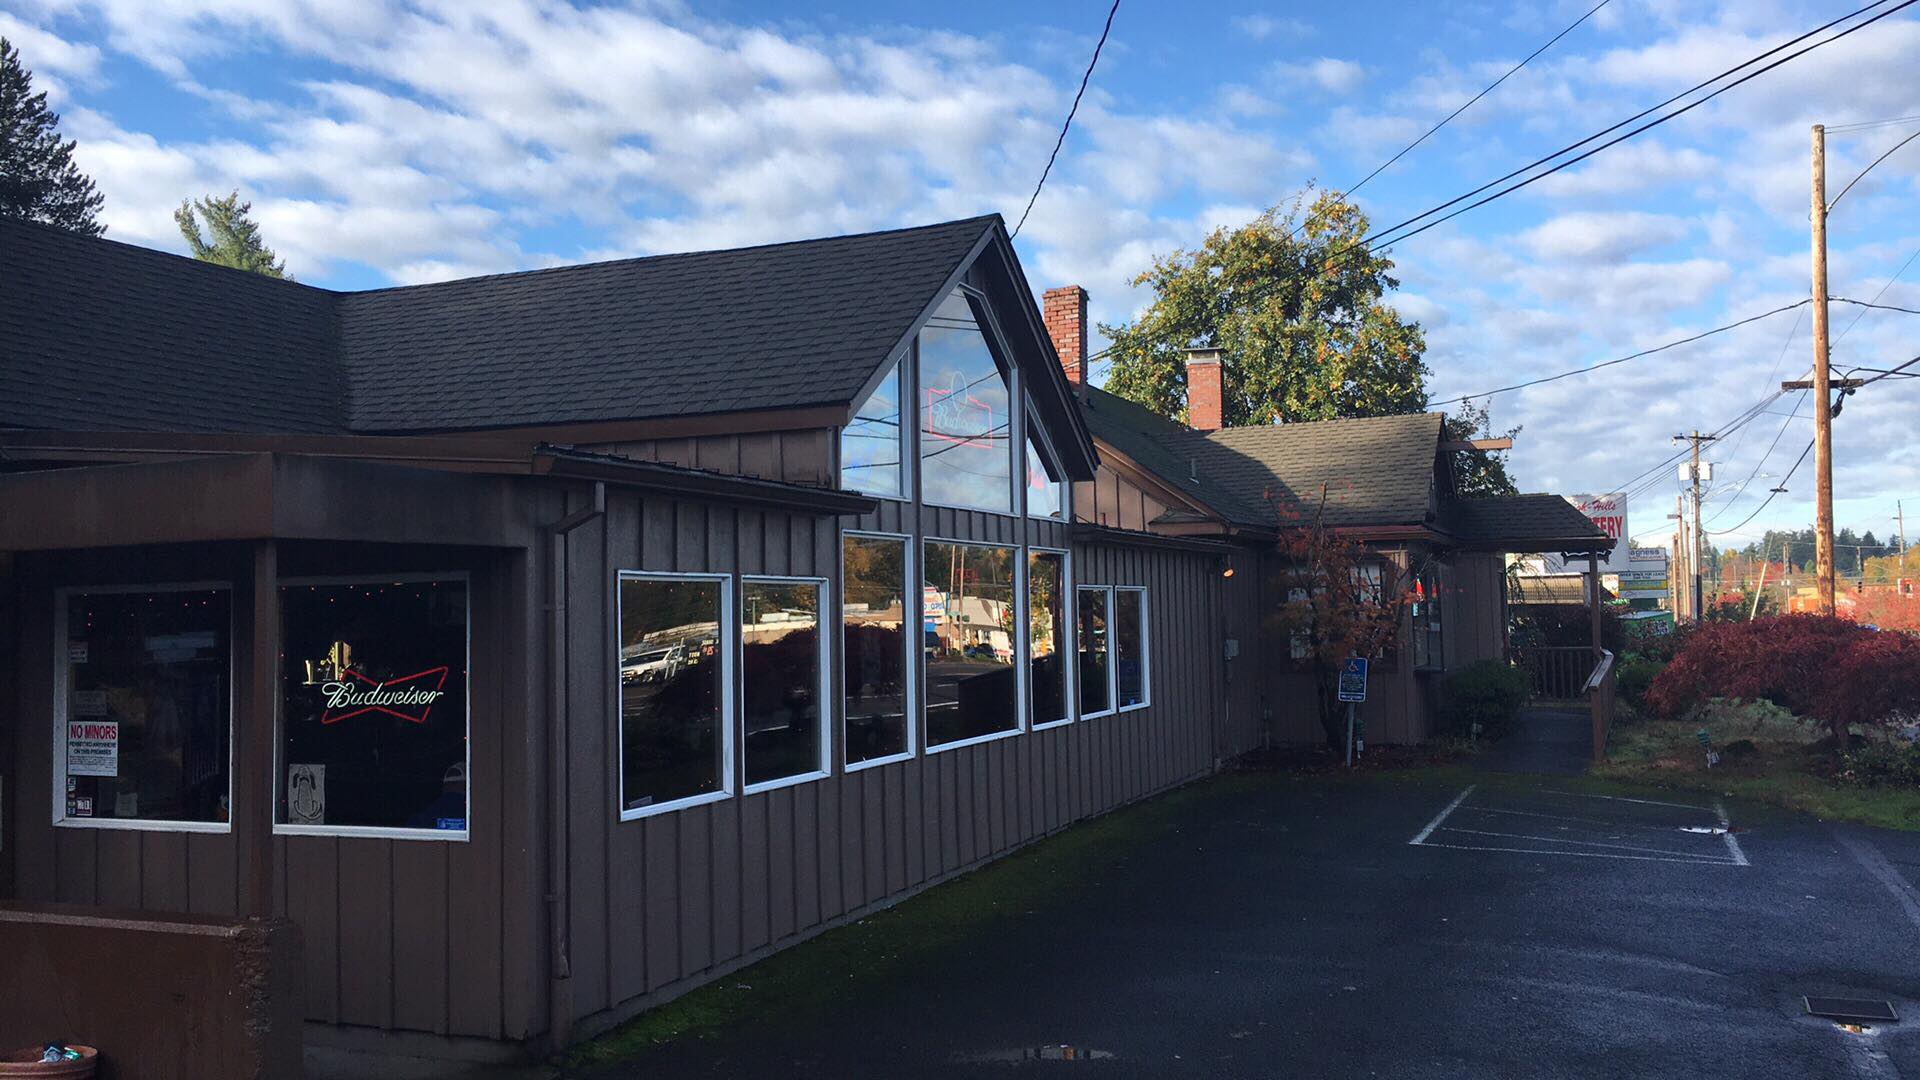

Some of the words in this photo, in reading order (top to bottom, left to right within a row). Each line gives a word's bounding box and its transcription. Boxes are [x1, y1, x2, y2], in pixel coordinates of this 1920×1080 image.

[1592, 500, 1616, 511] Hills
[321, 682, 444, 708] Budweiser
[70, 724, 83, 739] NO
[85, 725, 117, 740] MINORS
